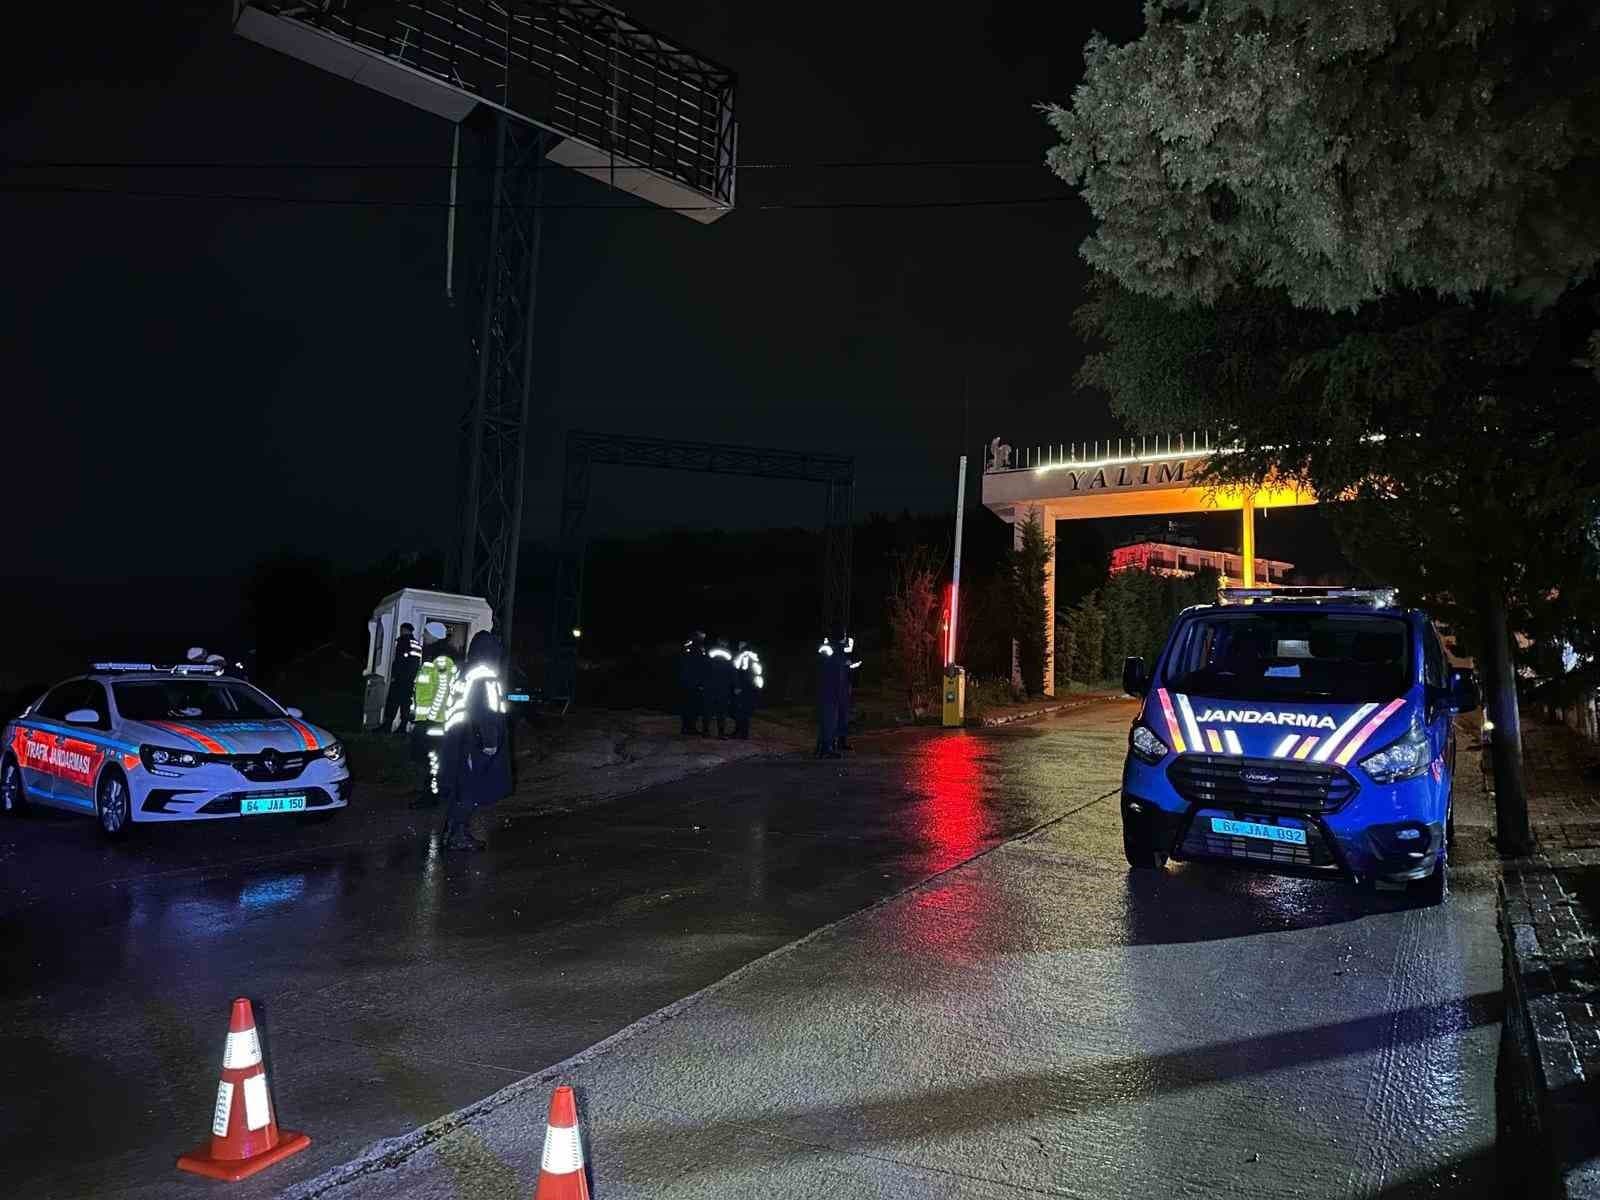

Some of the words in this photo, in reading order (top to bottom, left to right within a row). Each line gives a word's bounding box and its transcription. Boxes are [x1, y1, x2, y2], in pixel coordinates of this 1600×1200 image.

[1068, 461, 1186, 491] YALIM
[1196, 709, 1336, 730] JANDARMA
[49, 747, 91, 774] JANDARMASI
[247, 801, 258, 811] 64
[268, 800, 283, 810] JAA
[288, 799, 303, 809] 150
[1247, 825, 1269, 837] JAA
[1278, 828, 1302, 841] 092
